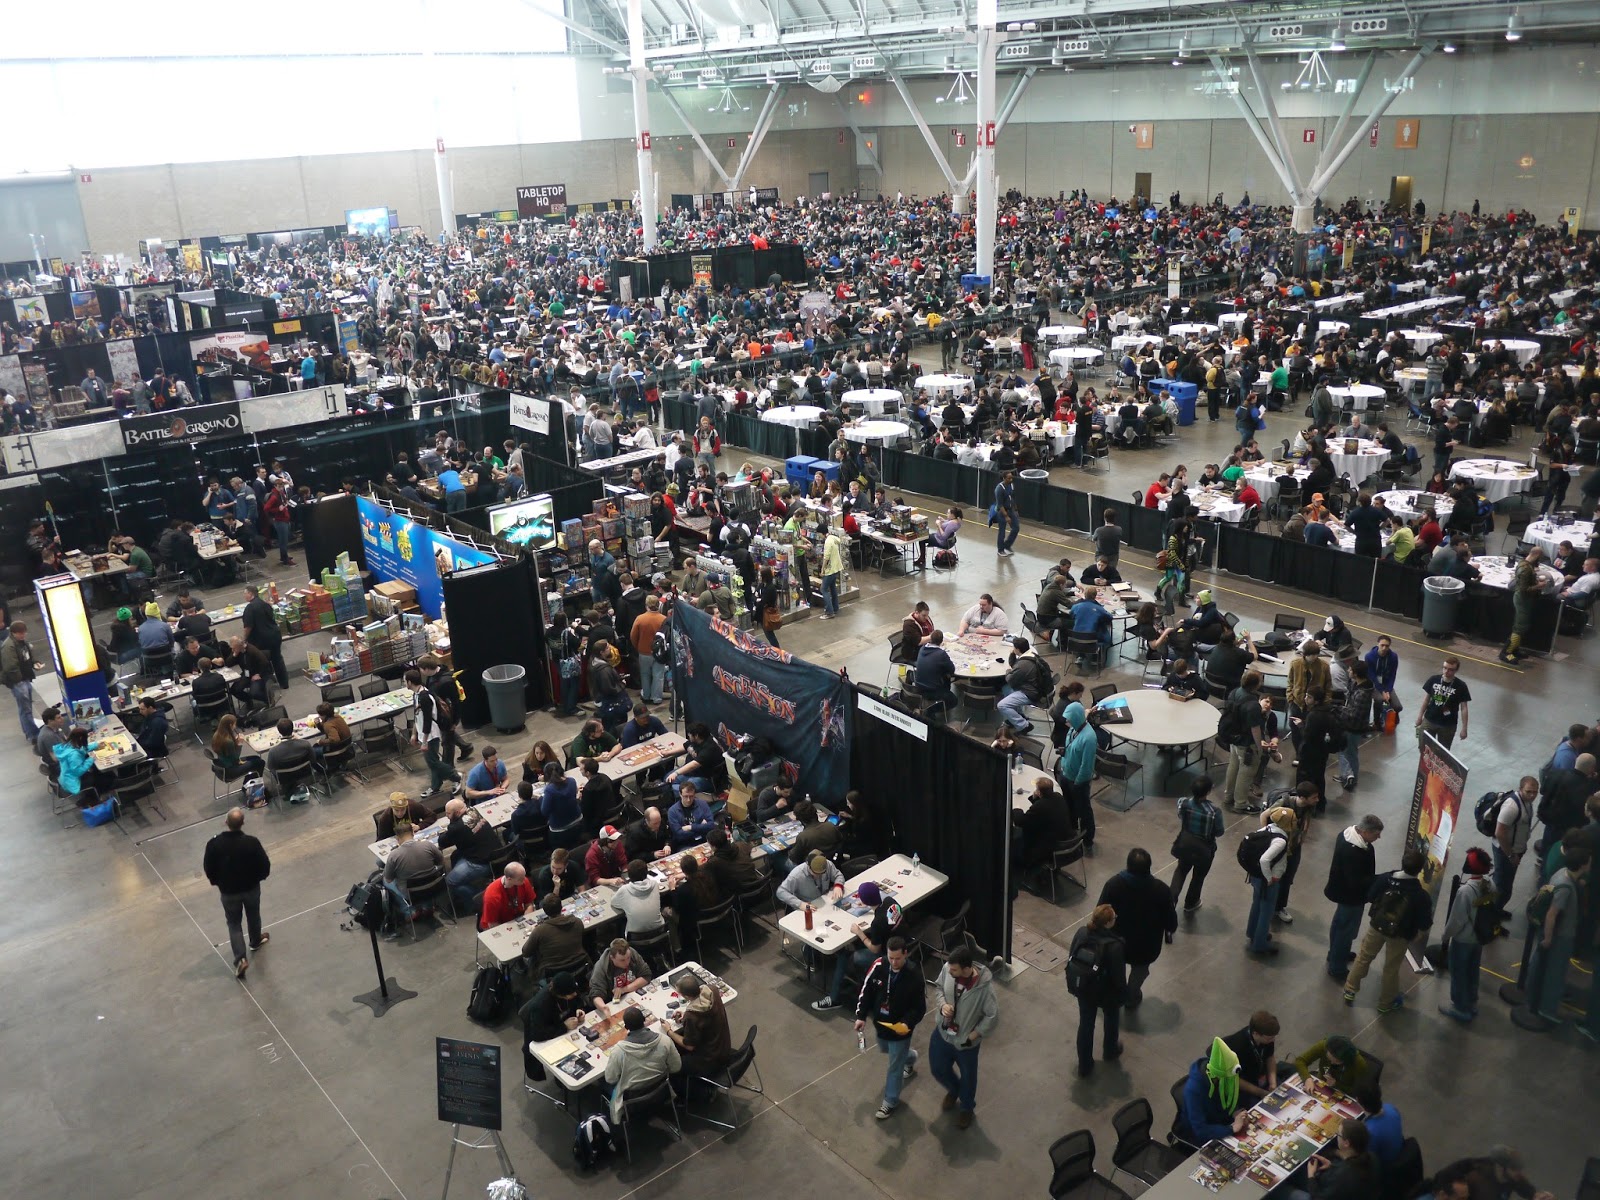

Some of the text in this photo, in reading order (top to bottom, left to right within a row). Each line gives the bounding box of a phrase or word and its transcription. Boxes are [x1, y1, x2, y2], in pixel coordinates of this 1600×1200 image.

[518, 186, 564, 198] TABLETOP
[536, 197, 549, 206] HQ
[1432, 683, 1456, 694] CRANK
[712, 665, 797, 725] ASCENSION
[1408, 778, 1424, 847] MARSHALLING
